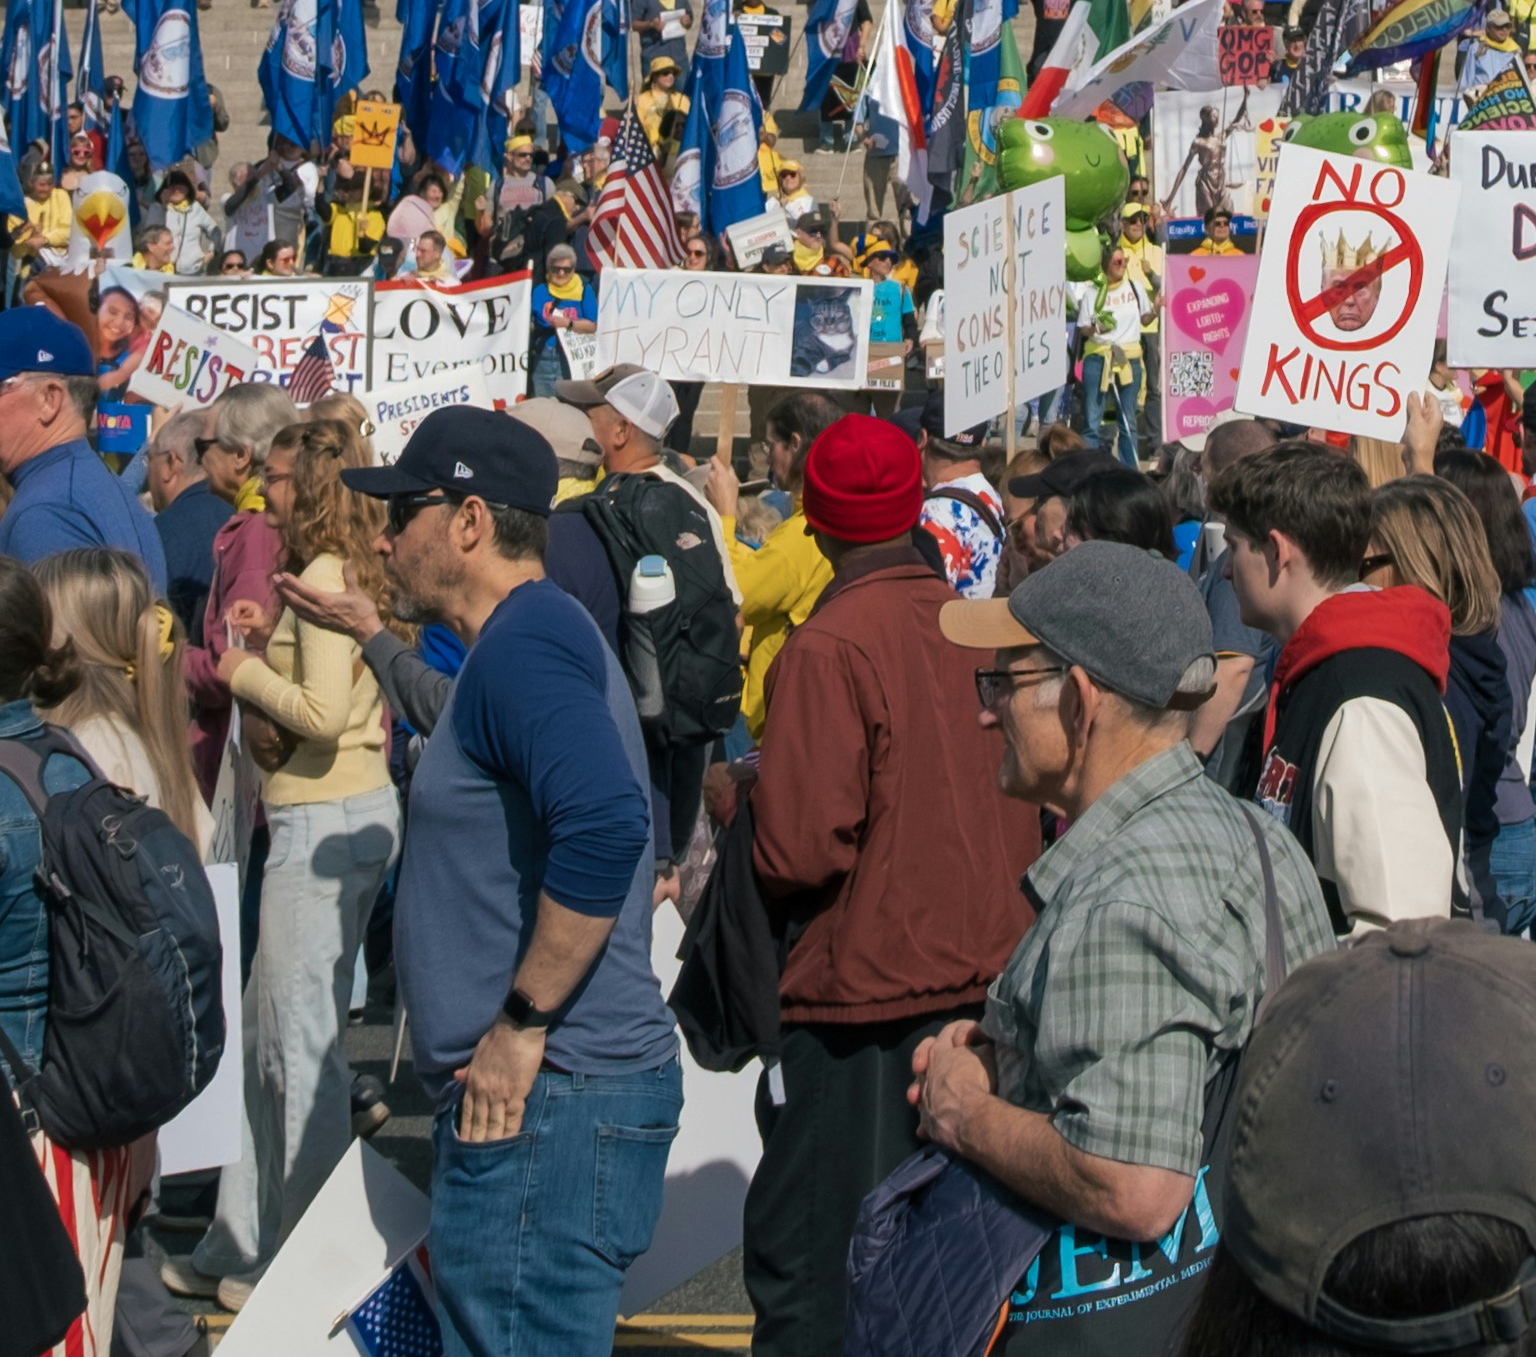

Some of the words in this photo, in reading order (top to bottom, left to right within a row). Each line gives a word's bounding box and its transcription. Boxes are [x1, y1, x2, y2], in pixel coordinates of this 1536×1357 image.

[1220, 28, 1271, 53] OMG
[1220, 51, 1271, 77] GOP
[1313, 159, 1405, 210] NO
[957, 201, 1052, 270] SCIENCE
[989, 250, 1032, 298] NOT
[185, 292, 309, 332] RESIST
[373, 294, 513, 342] LOVE
[601, 275, 667, 319] MY
[676, 280, 787, 323] ONLY
[1186, 292, 1230, 315] EXPANDING
[601, 326, 781, 375] TYRANT
[1202, 326, 1231, 343] RIGHTS
[145, 330, 245, 405] RESIST
[387, 349, 531, 383] Everyone
[962, 329, 1052, 399] THEOIES
[1262, 342, 1403, 419] KINGS
[376, 385, 472, 421] PRESIDENTS
[1026, 1306, 1074, 1323] JOURNAL
[1077, 1301, 1093, 1314] OF
[1096, 1274, 1179, 1311] EXPERIMENTAL
[1181, 1256, 1214, 1280] MEDIC
